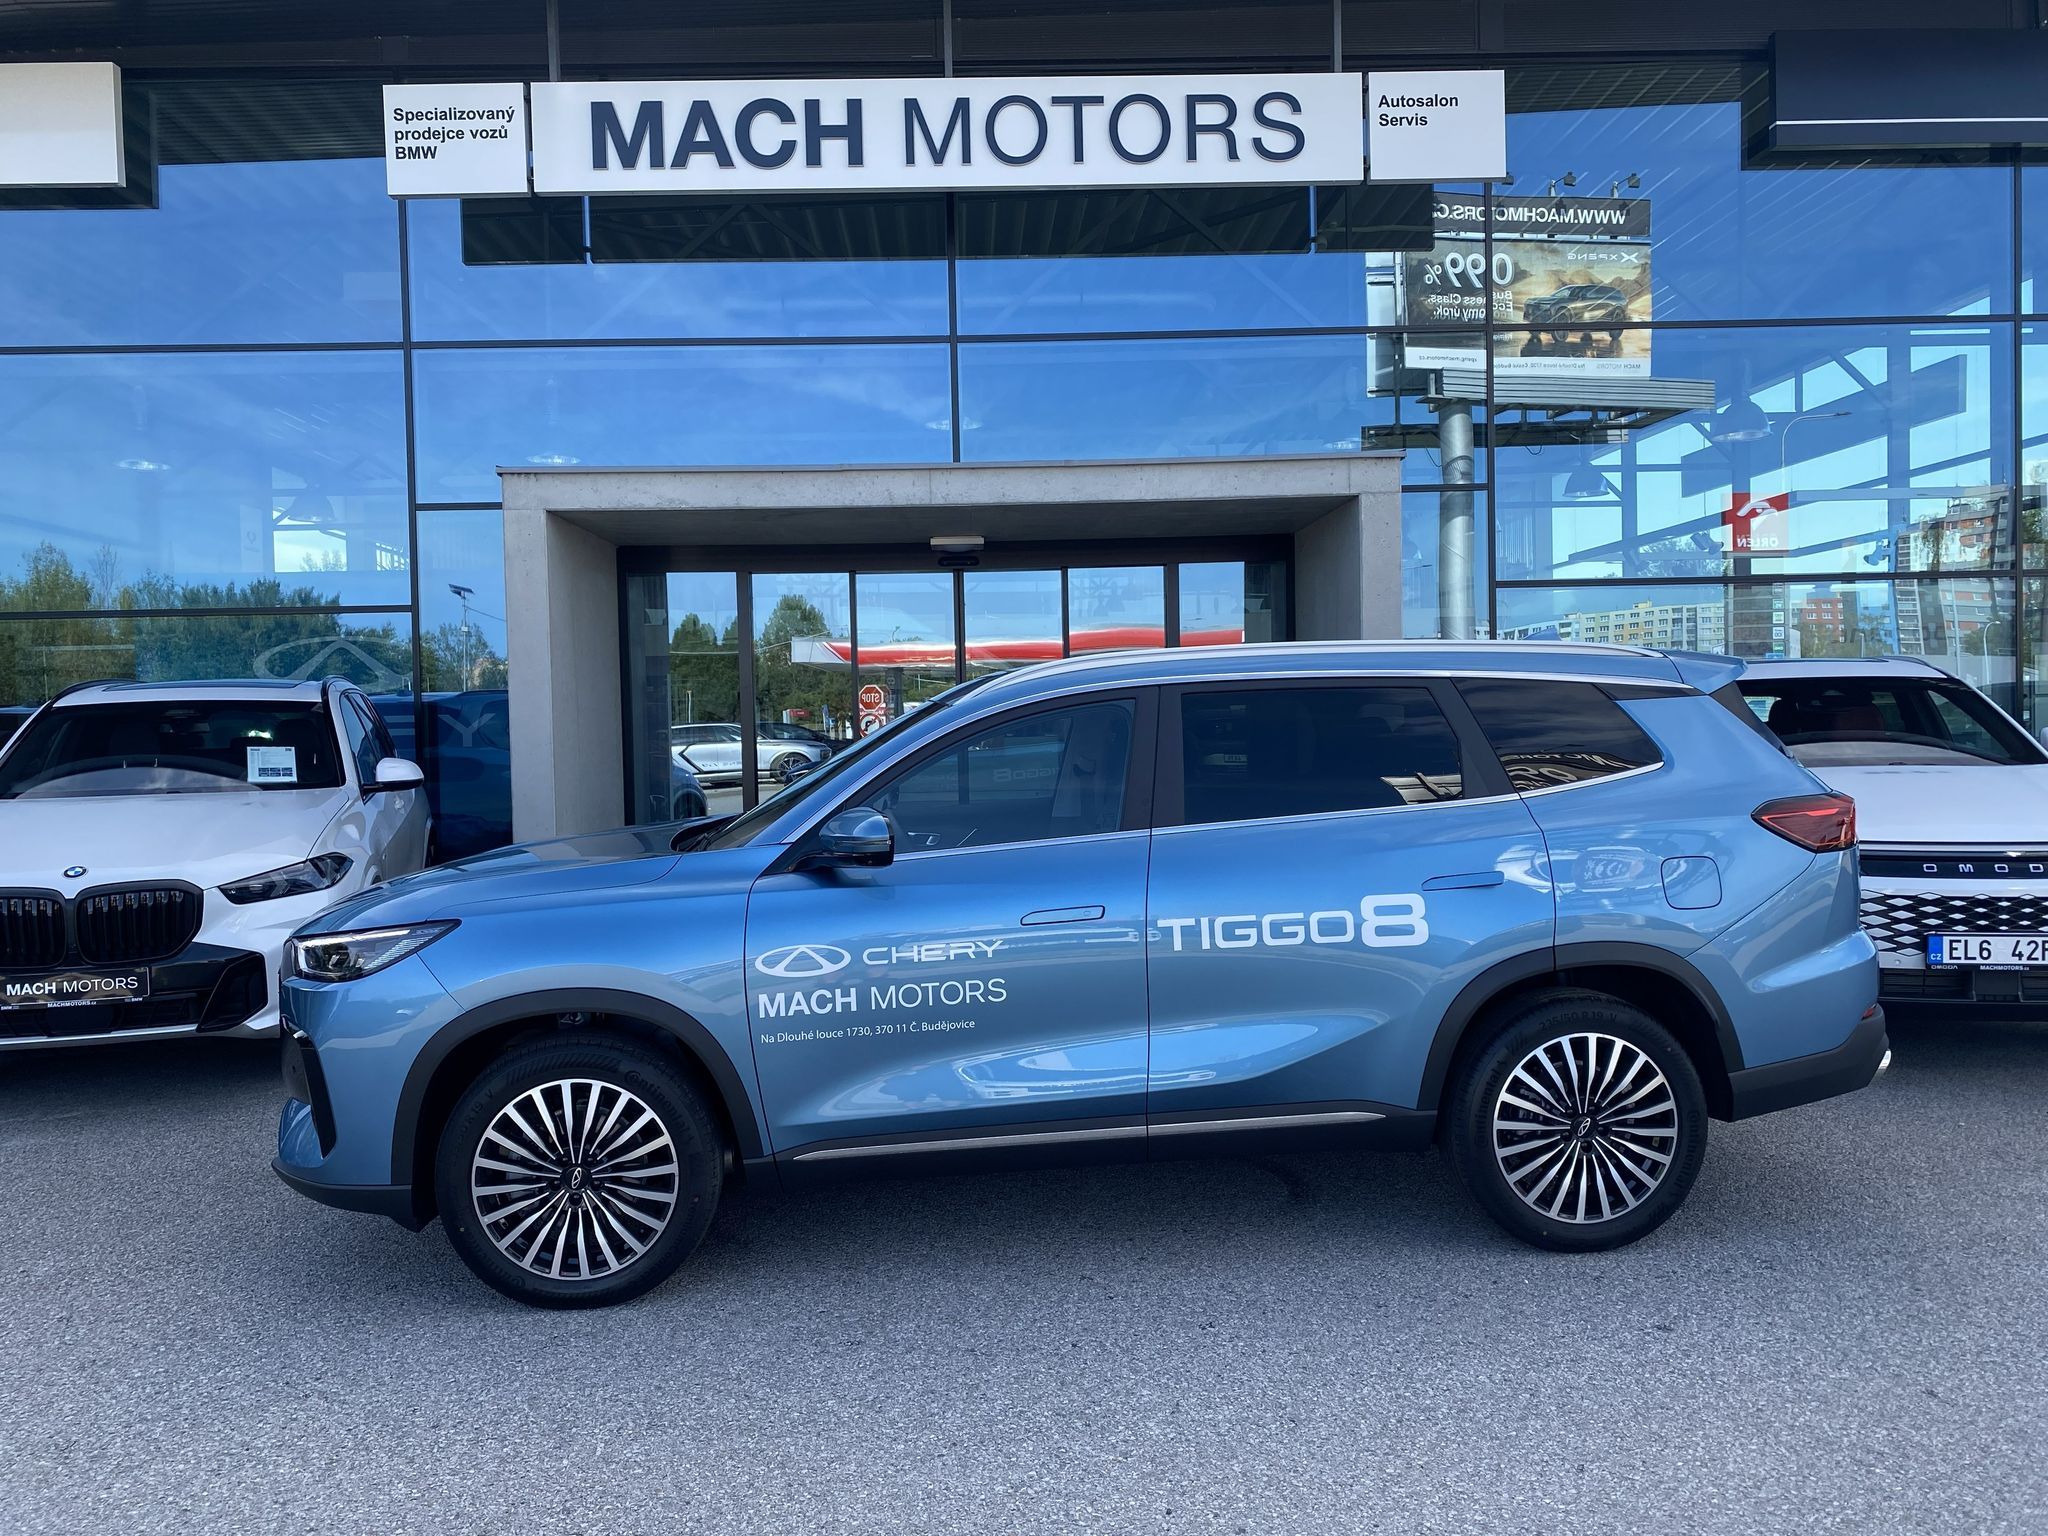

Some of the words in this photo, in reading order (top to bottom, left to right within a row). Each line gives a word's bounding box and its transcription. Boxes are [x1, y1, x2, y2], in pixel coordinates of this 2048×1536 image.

[1378, 93, 1459, 108] Autosalon
[393, 106, 515, 124] Specializovaný
[1378, 112, 1428, 127] Servis
[394, 127, 465, 143] prodejce
[469, 125, 508, 139] vozů
[590, 98, 864, 171] MACH
[904, 92, 1306, 166] MOTORS
[395, 146, 437, 159] BMW
[862, 940, 1004, 966] CHERY
[1949, 939, 1992, 961] EL6
[5, 982, 56, 996] MACH
[63, 976, 139, 993] MOTORS
[758, 987, 858, 1019] MACH
[870, 978, 1007, 1010] MOTORS
[761, 1034, 775, 1043] Na
[777, 1030, 814, 1042] Dlouhé
[816, 1028, 844, 1039] louce
[847, 1026, 873, 1037] 1730,
[875, 1024, 894, 1034] 370
[896, 1023, 906, 1032] 11
[909, 1021, 919, 1032] Č.
[922, 1018, 976, 1034] Budějovice
